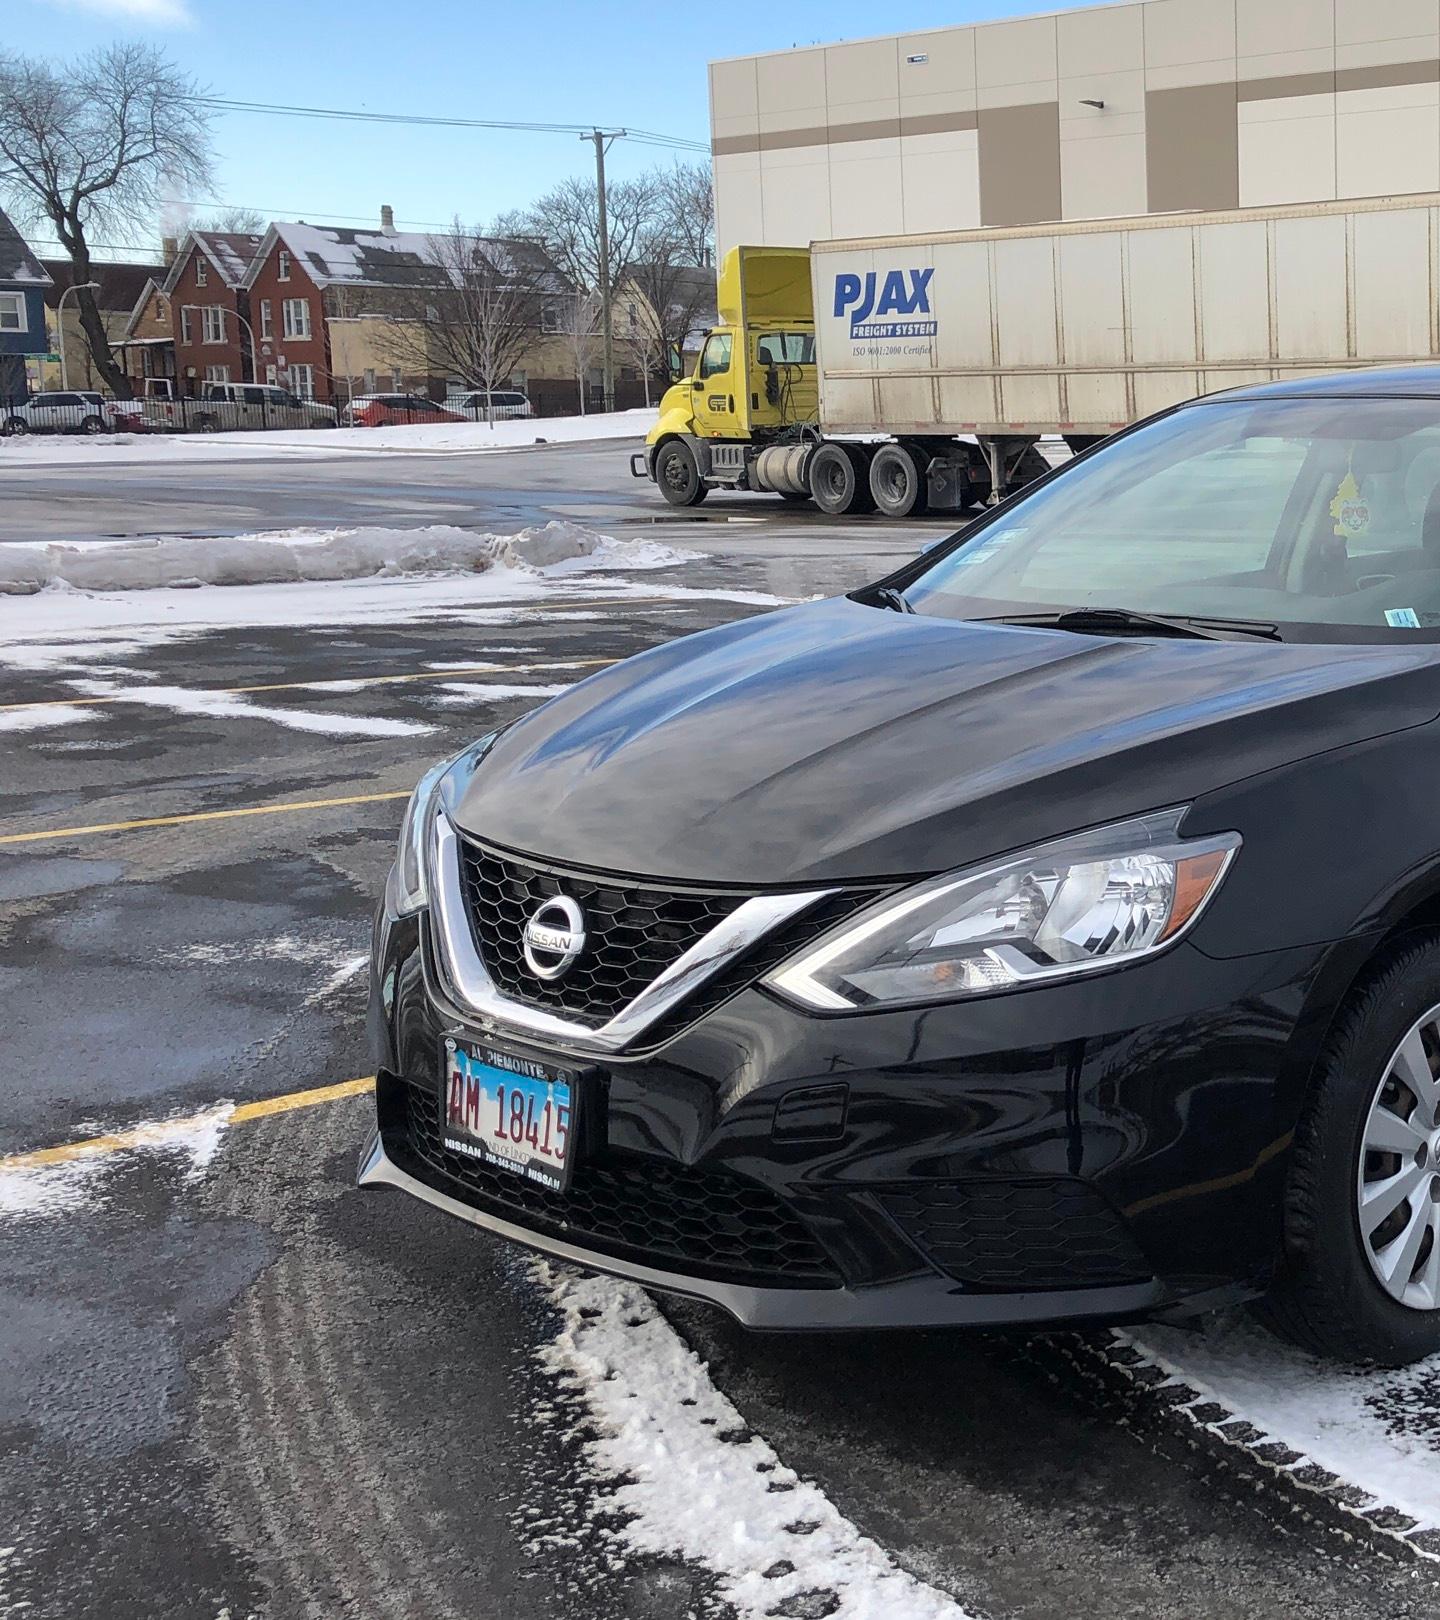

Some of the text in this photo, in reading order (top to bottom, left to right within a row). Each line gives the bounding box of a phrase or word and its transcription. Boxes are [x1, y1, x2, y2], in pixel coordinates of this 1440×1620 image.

[833, 268, 935, 325] PJAX
[852, 323, 934, 337] FREIGHT SYSTEM
[852, 347, 866, 357] ISO
[526, 925, 572, 950] NISSAN
[471, 1044, 482, 1061] AL
[449, 1070, 570, 1160] AM 18415
[444, 1137, 482, 1158] NISSAN
[528, 1168, 560, 1190] NISSAN
